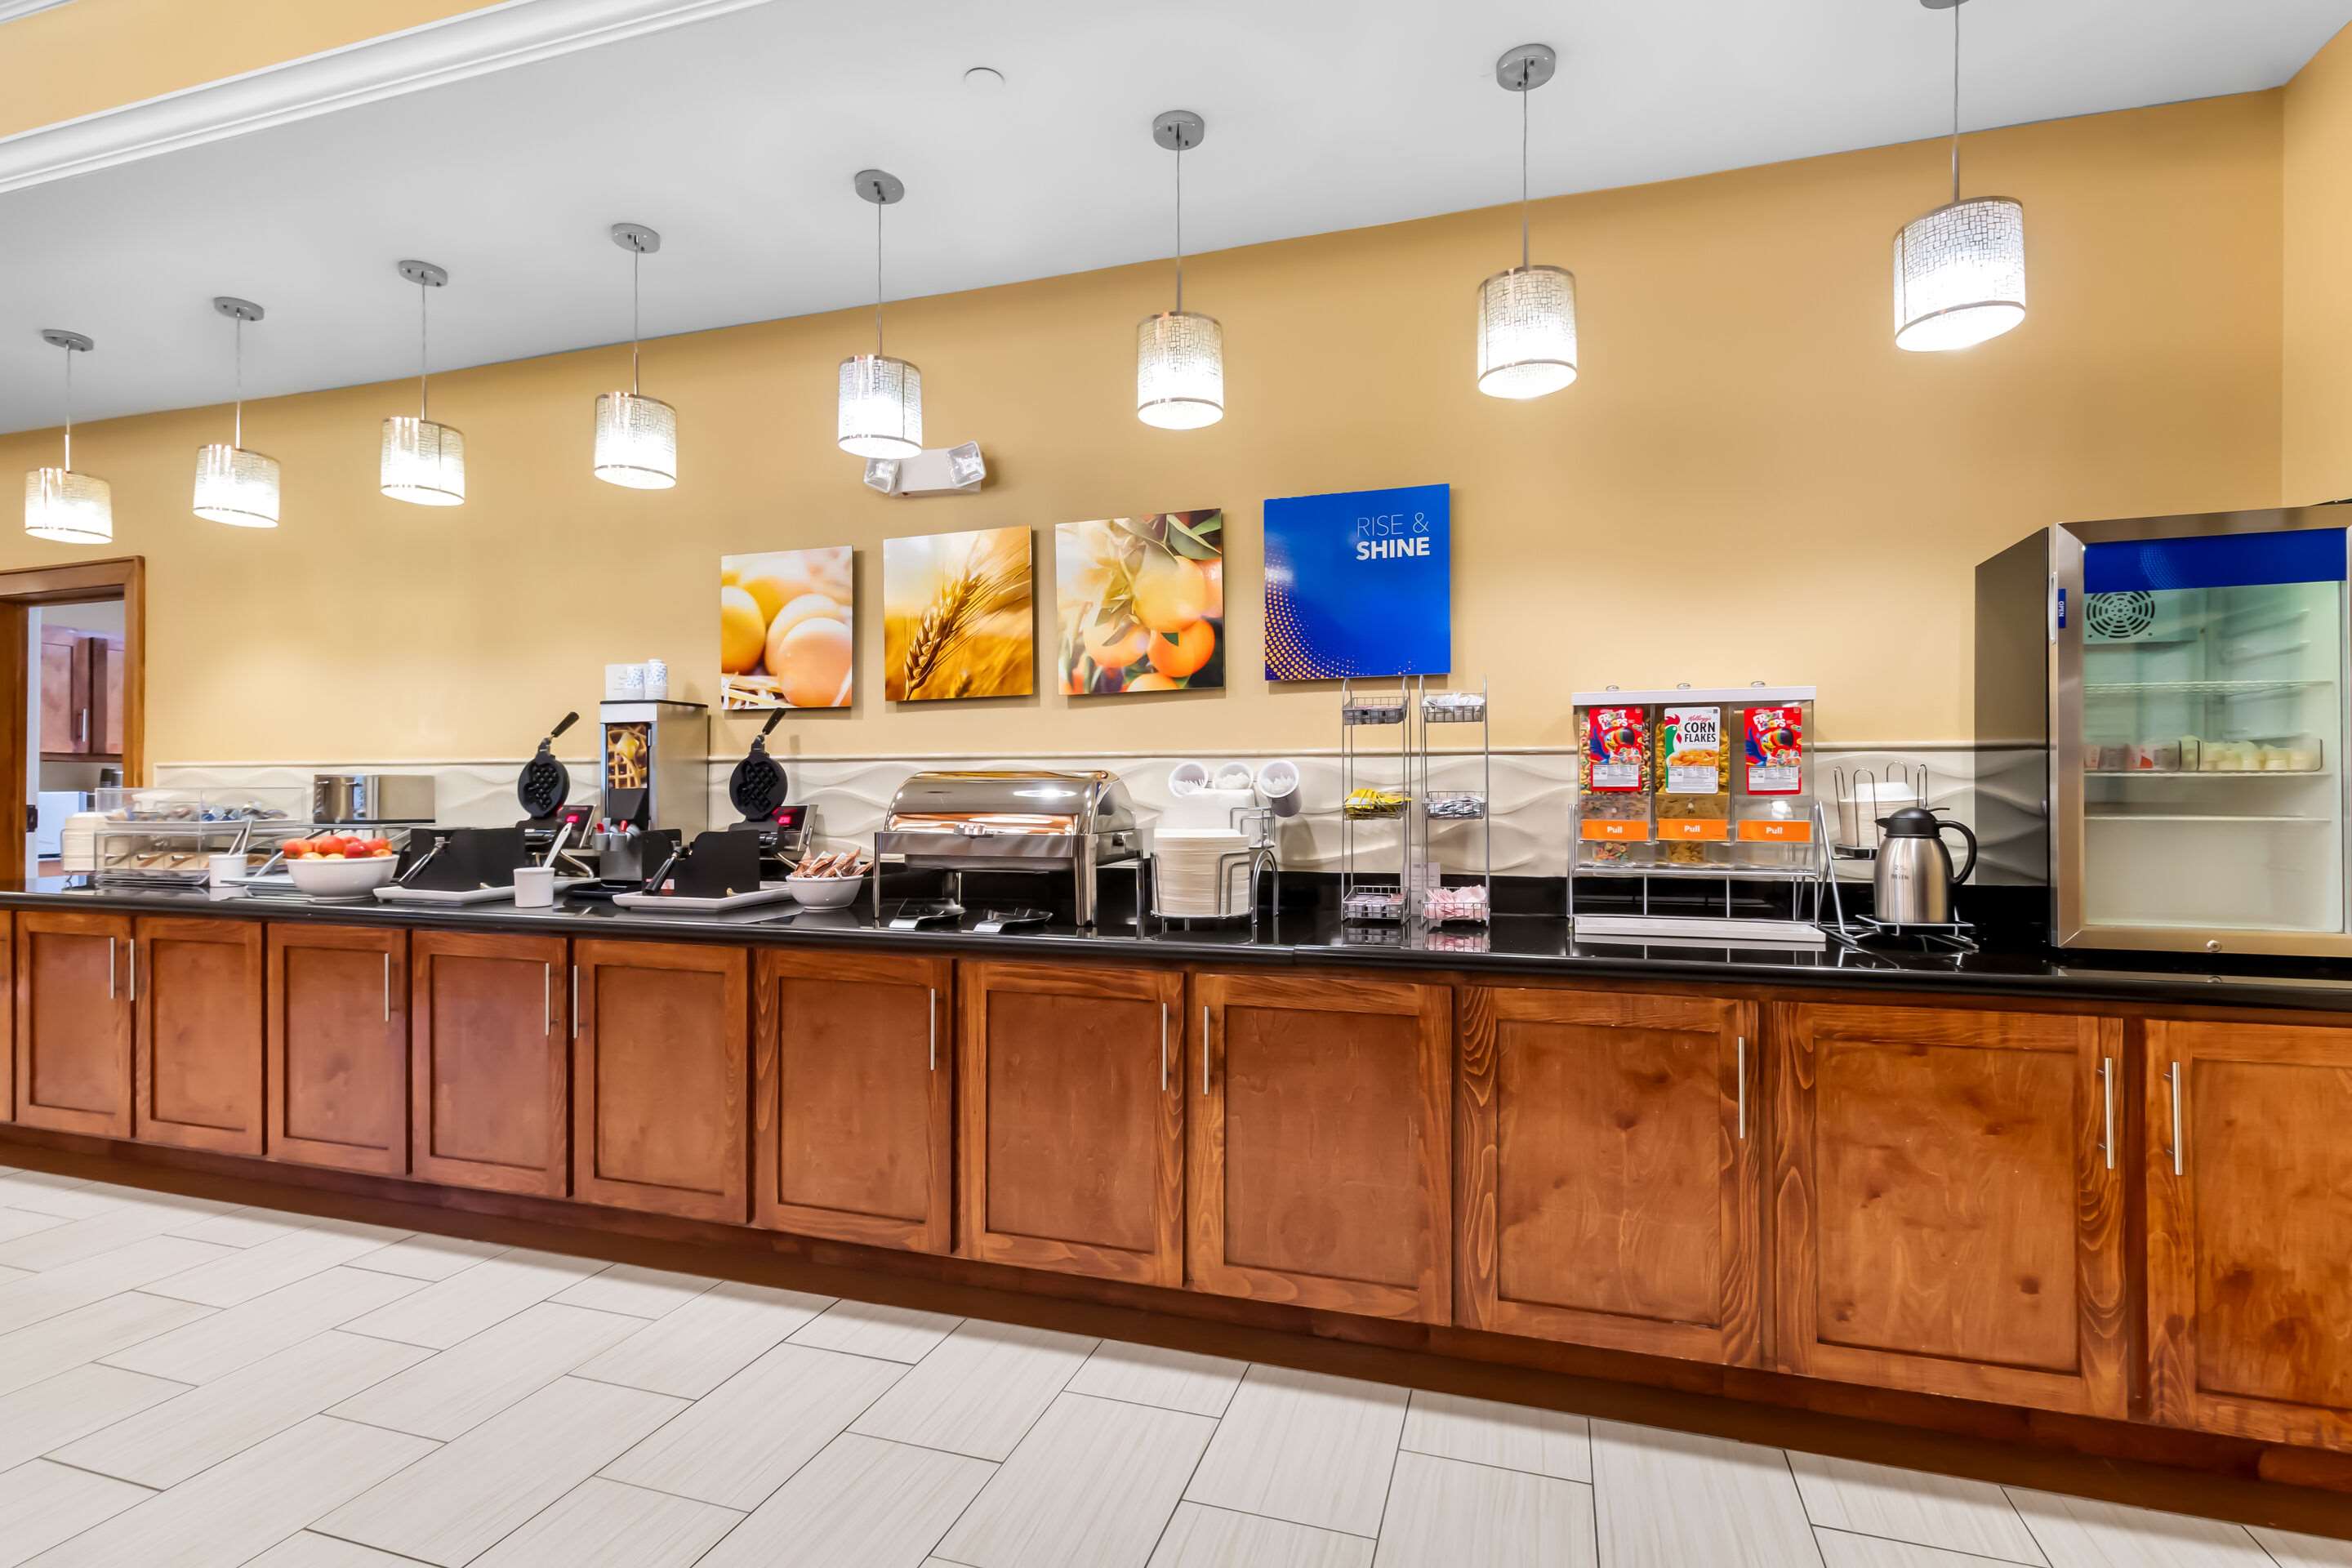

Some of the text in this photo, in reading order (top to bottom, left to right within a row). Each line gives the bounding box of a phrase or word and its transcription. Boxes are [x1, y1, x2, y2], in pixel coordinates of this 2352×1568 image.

[1357, 512, 1429, 537] RISE &
[1356, 537, 1431, 561] SHINE
[1684, 722, 1716, 733] CORN
[1684, 733, 1717, 742] FLAKES
[1606, 826, 1624, 834] Pull
[1684, 825, 1701, 833] Pull
[1766, 826, 1783, 835] Pull
